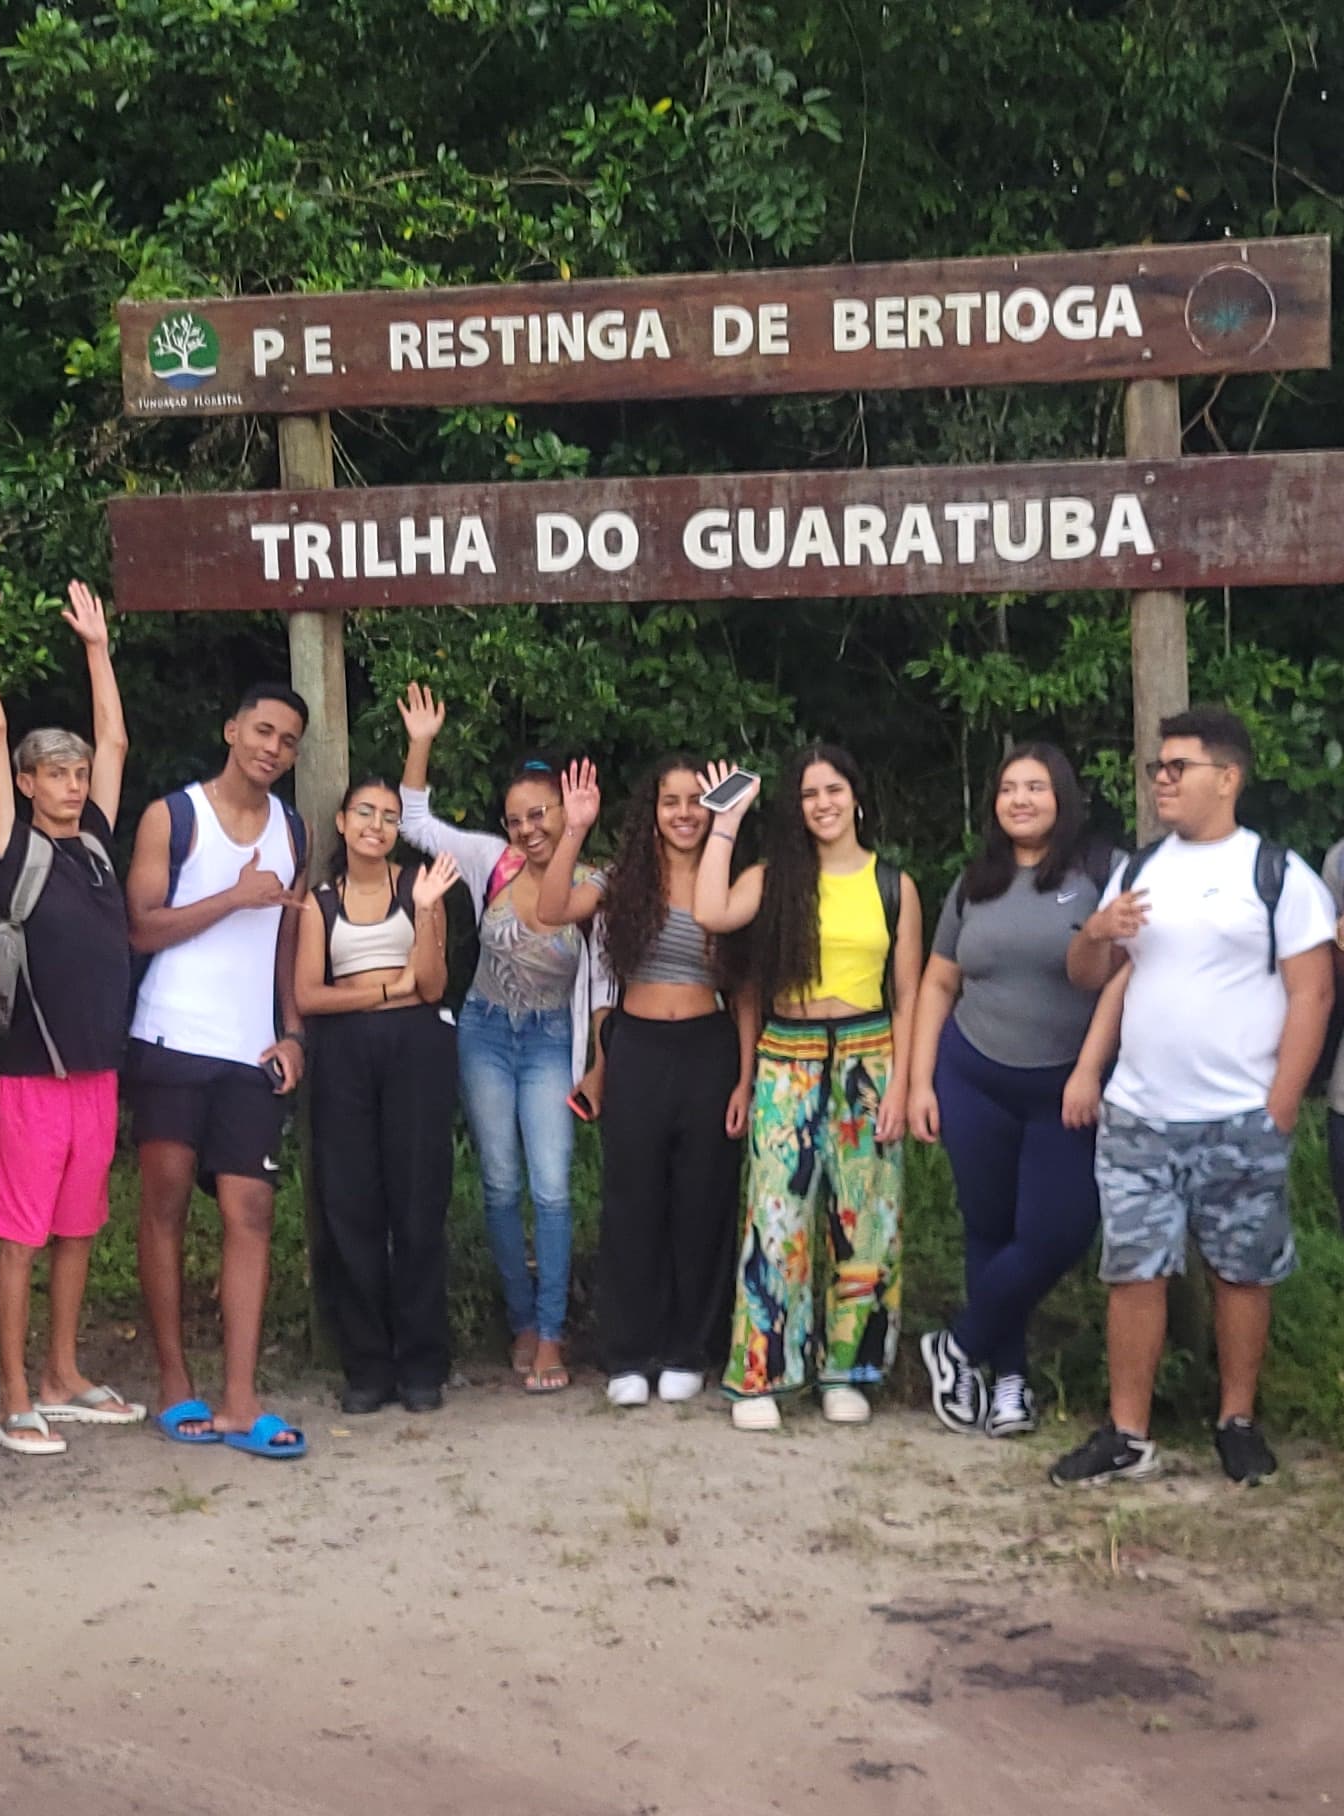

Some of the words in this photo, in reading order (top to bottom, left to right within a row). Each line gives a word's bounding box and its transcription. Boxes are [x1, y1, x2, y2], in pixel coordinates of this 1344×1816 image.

[389, 309, 670, 371] RESTINGA
[713, 303, 789, 356] DE
[833, 284, 1143, 351] BERTIOGA
[252, 515, 496, 581] TRILHA
[536, 510, 639, 574] DO
[683, 493, 1154, 570] GUARATUBA
